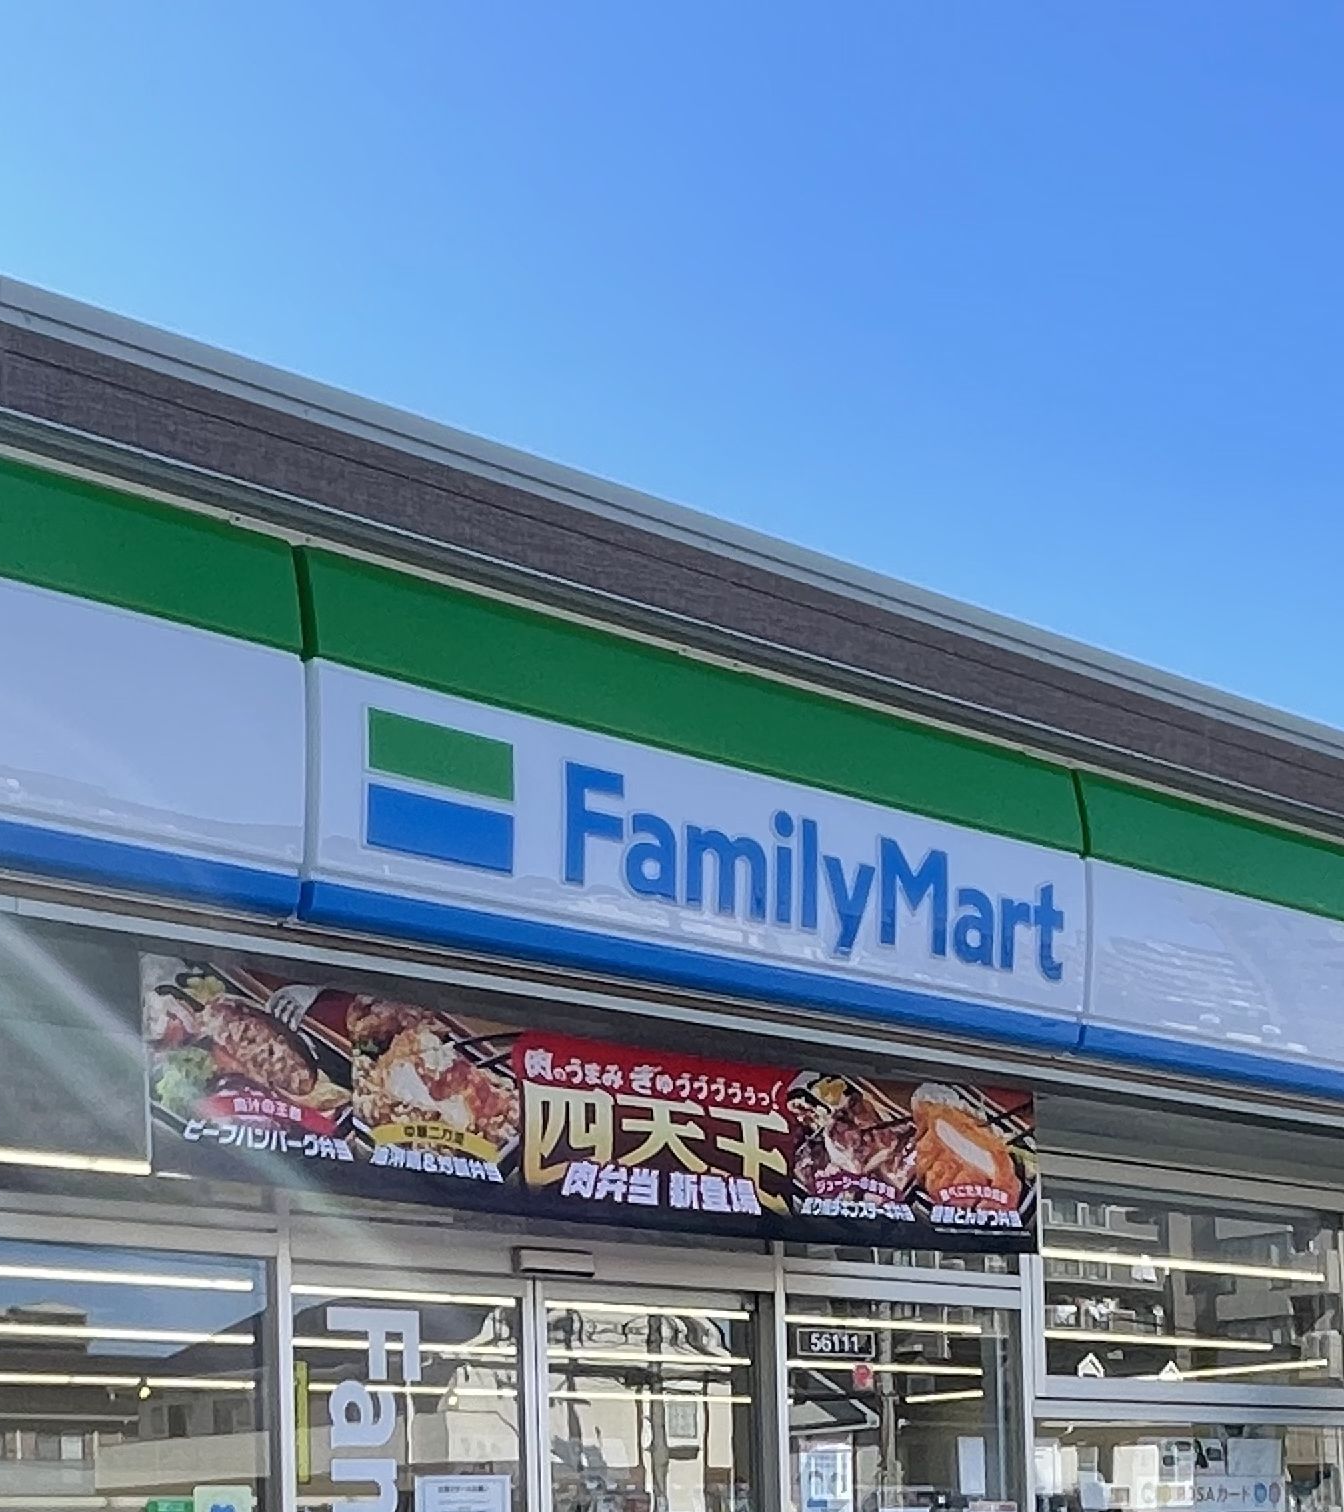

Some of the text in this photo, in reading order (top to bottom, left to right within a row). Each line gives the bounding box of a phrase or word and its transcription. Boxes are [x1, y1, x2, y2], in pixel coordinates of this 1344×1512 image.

[562, 760, 1065, 982] FamilyMart
[184, 1118, 354, 1162] ビーフハンバーグ弁当
[522, 1078, 791, 1216] 四天王
[561, 1160, 761, 1215] 肉弁当 新登場
